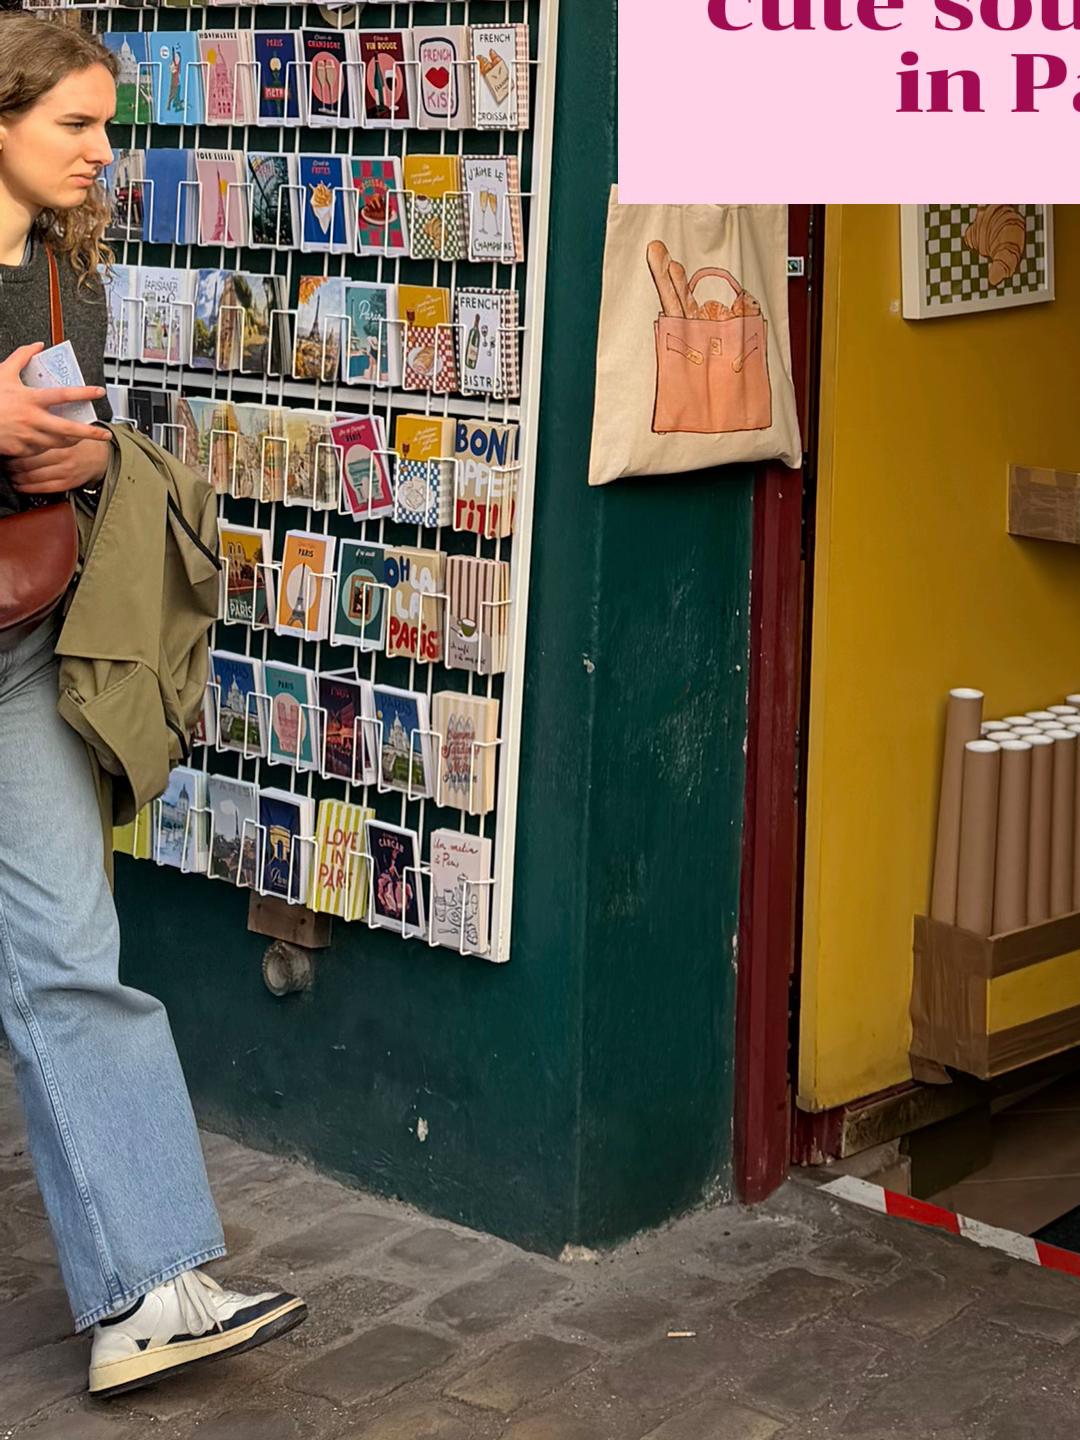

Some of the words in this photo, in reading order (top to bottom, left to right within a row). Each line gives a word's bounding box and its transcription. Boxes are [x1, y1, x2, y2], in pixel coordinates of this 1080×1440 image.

[479, 33, 511, 43] FRENCH
[423, 49, 451, 60] FRENCH
[494, 170, 503, 182] LE
[460, 297, 499, 309] FRENCH
[455, 423, 508, 465] BON
[383, 556, 410, 589] OH
[411, 563, 436, 593] LA
[326, 826, 359, 849] LOVE
[332, 850, 344, 866] IN
